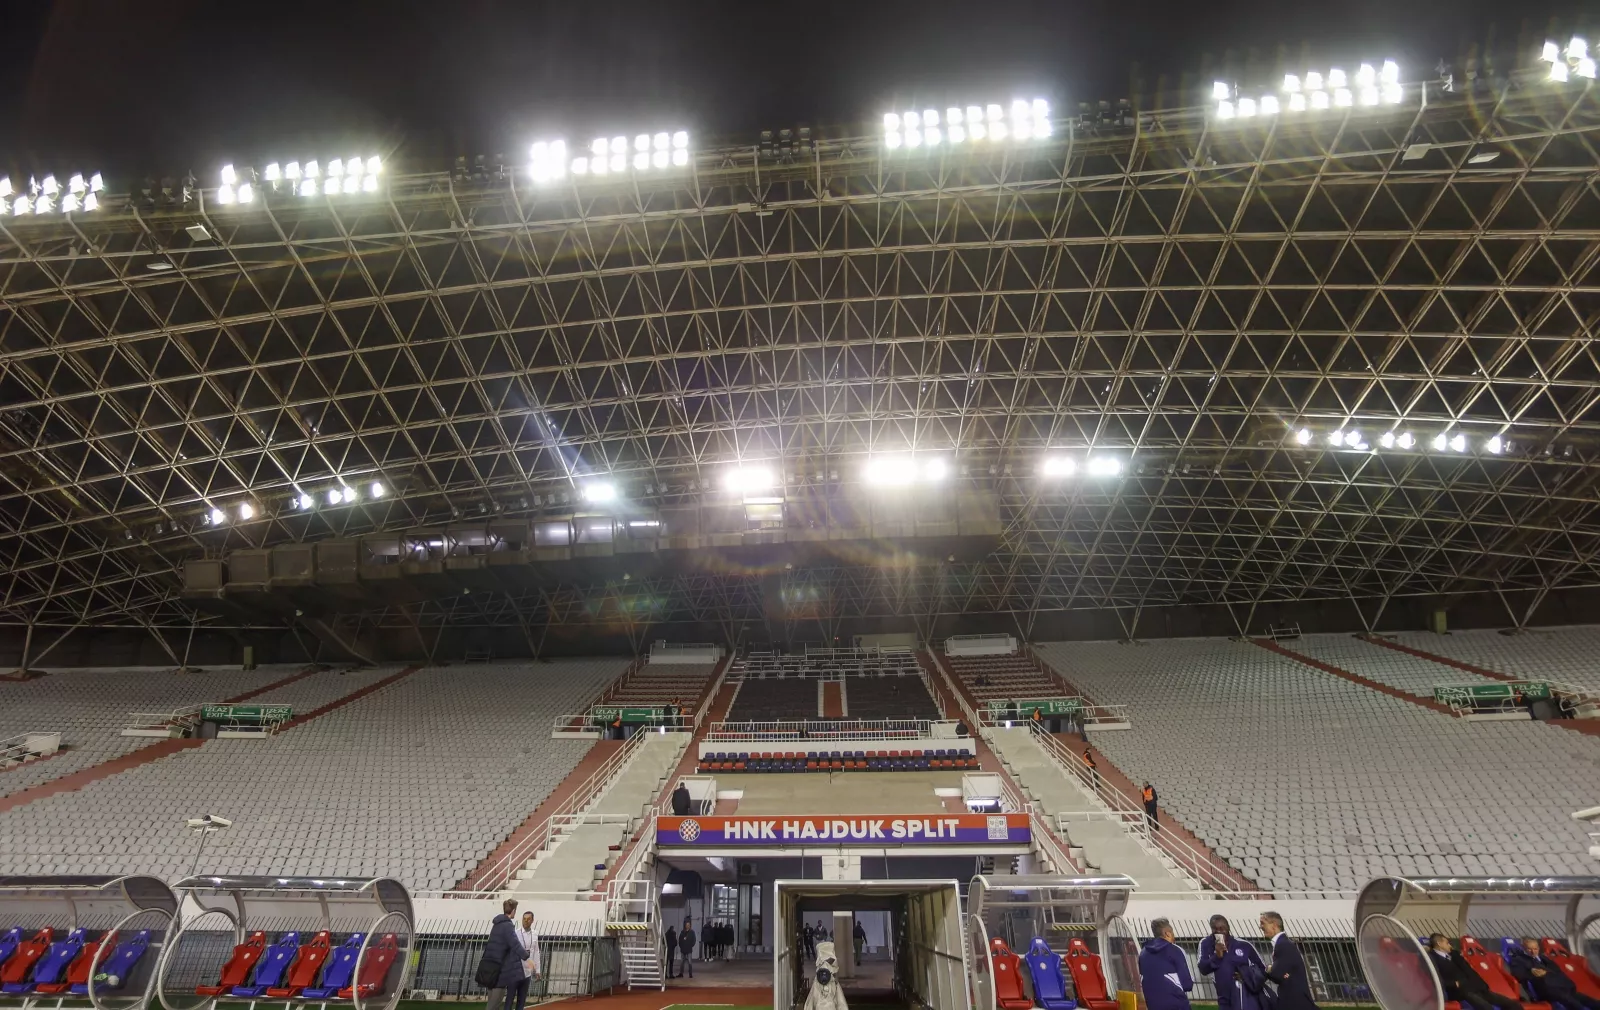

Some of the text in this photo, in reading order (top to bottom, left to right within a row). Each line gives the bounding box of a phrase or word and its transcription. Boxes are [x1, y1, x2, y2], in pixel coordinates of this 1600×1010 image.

[724, 820, 777, 840] HNK
[782, 819, 886, 840] HAJDUK
[891, 818, 960, 839] SPLIT
